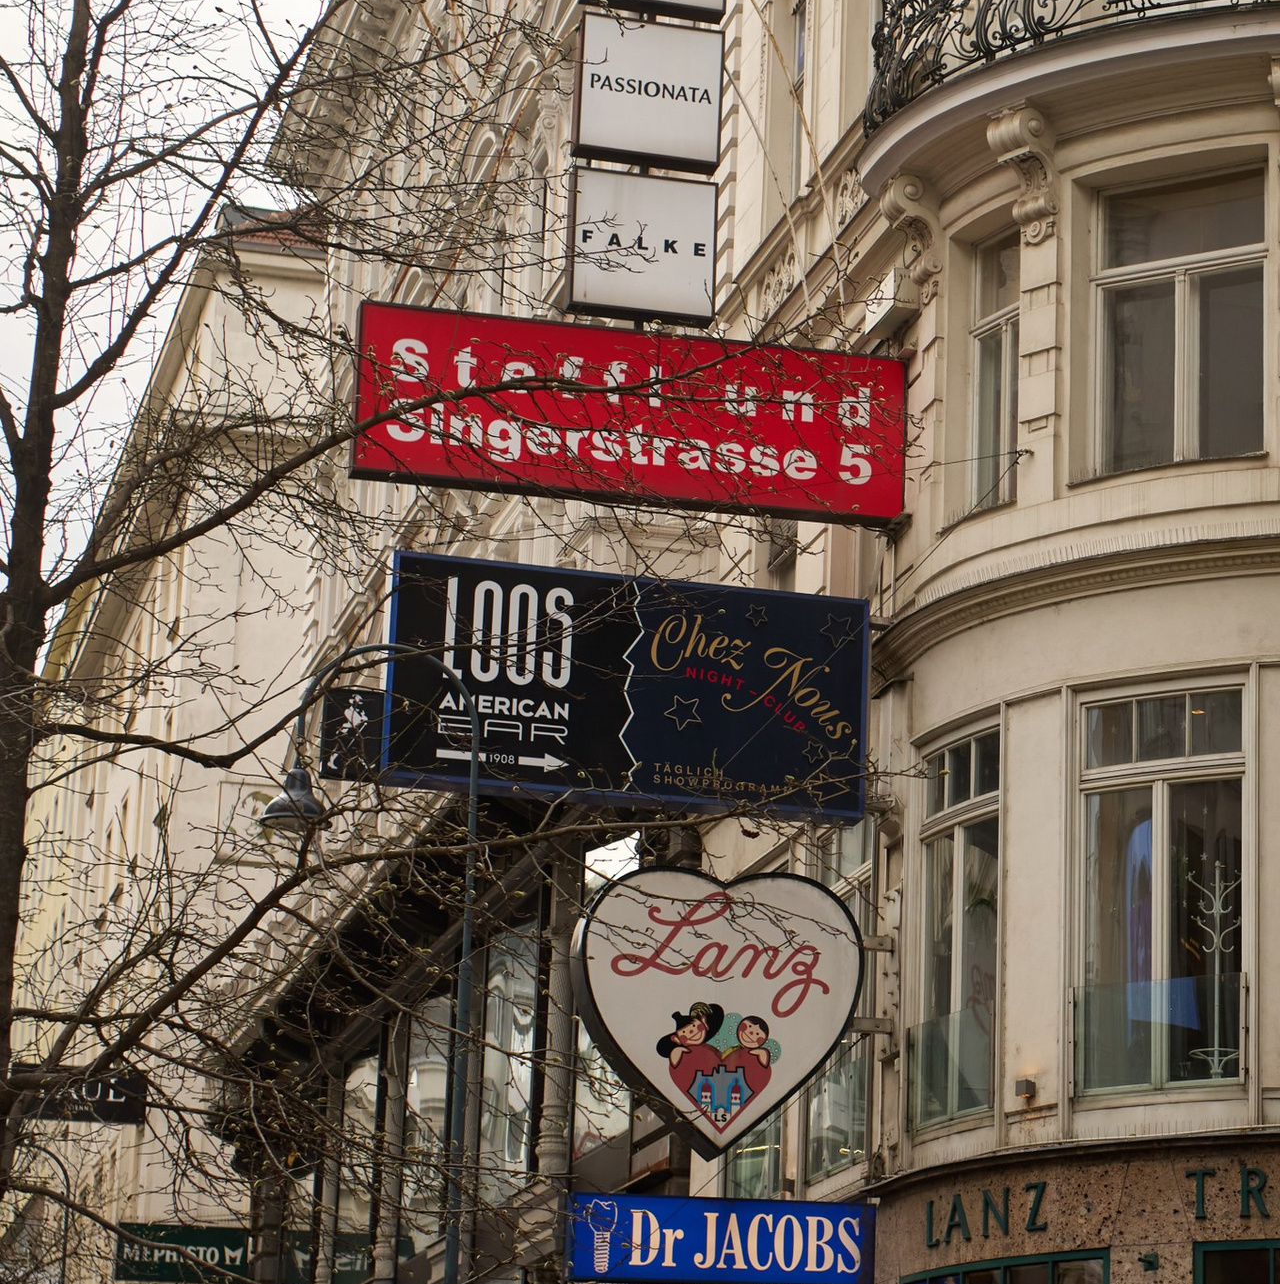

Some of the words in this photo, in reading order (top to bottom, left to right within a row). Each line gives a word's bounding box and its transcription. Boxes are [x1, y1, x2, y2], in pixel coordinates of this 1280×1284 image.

[590, 72, 713, 105] PASSIONATA
[581, 229, 706, 257] FALKE
[724, 384, 871, 428] und
[386, 398, 818, 481] Singerstrasse
[838, 443, 872, 485] 5
[443, 576, 575, 689] LOOS
[650, 613, 752, 671] Chez
[721, 647, 852, 740] Nous
[685, 667, 745, 691] NIGHT
[764, 694, 807, 733] CLUB
[437, 715, 569, 746] BAR
[489, 753, 515, 765] 1908
[653, 762, 724, 779] TÄGLICH
[610, 891, 830, 1019] Lanz
[714, 1114, 727, 1123] LS
[628, 1209, 685, 1268] Dr
[693, 1212, 862, 1274] JACOBS
[925, 1180, 1048, 1249] LANZ
